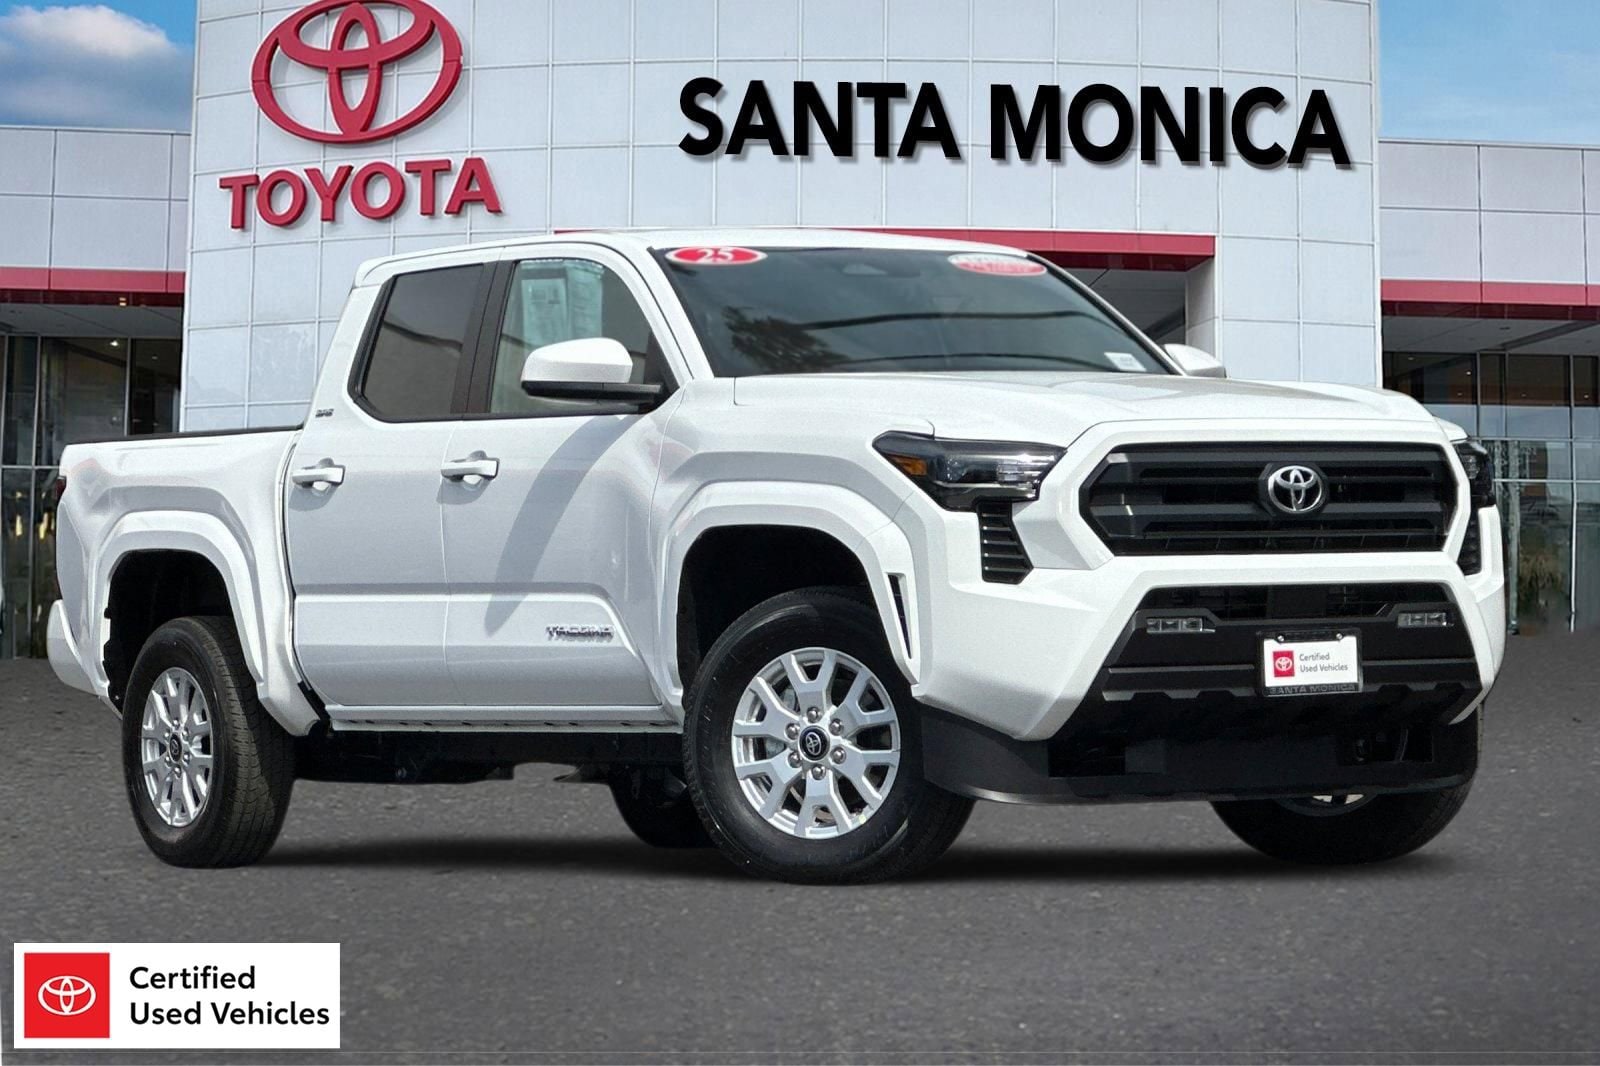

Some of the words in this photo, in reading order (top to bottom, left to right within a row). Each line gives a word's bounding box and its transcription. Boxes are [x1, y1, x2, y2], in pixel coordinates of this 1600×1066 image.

[678, 77, 963, 159] SANTA
[990, 83, 1352, 169] MONICA
[219, 157, 502, 229] TOYOTA
[696, 247, 734, 265] 25
[1299, 652, 1330, 661] Certified
[1300, 664, 1318, 672] Used
[1319, 662, 1348, 671] Vehicles
[1269, 686, 1307, 695] SANTA
[1309, 684, 1356, 693] MONICA
